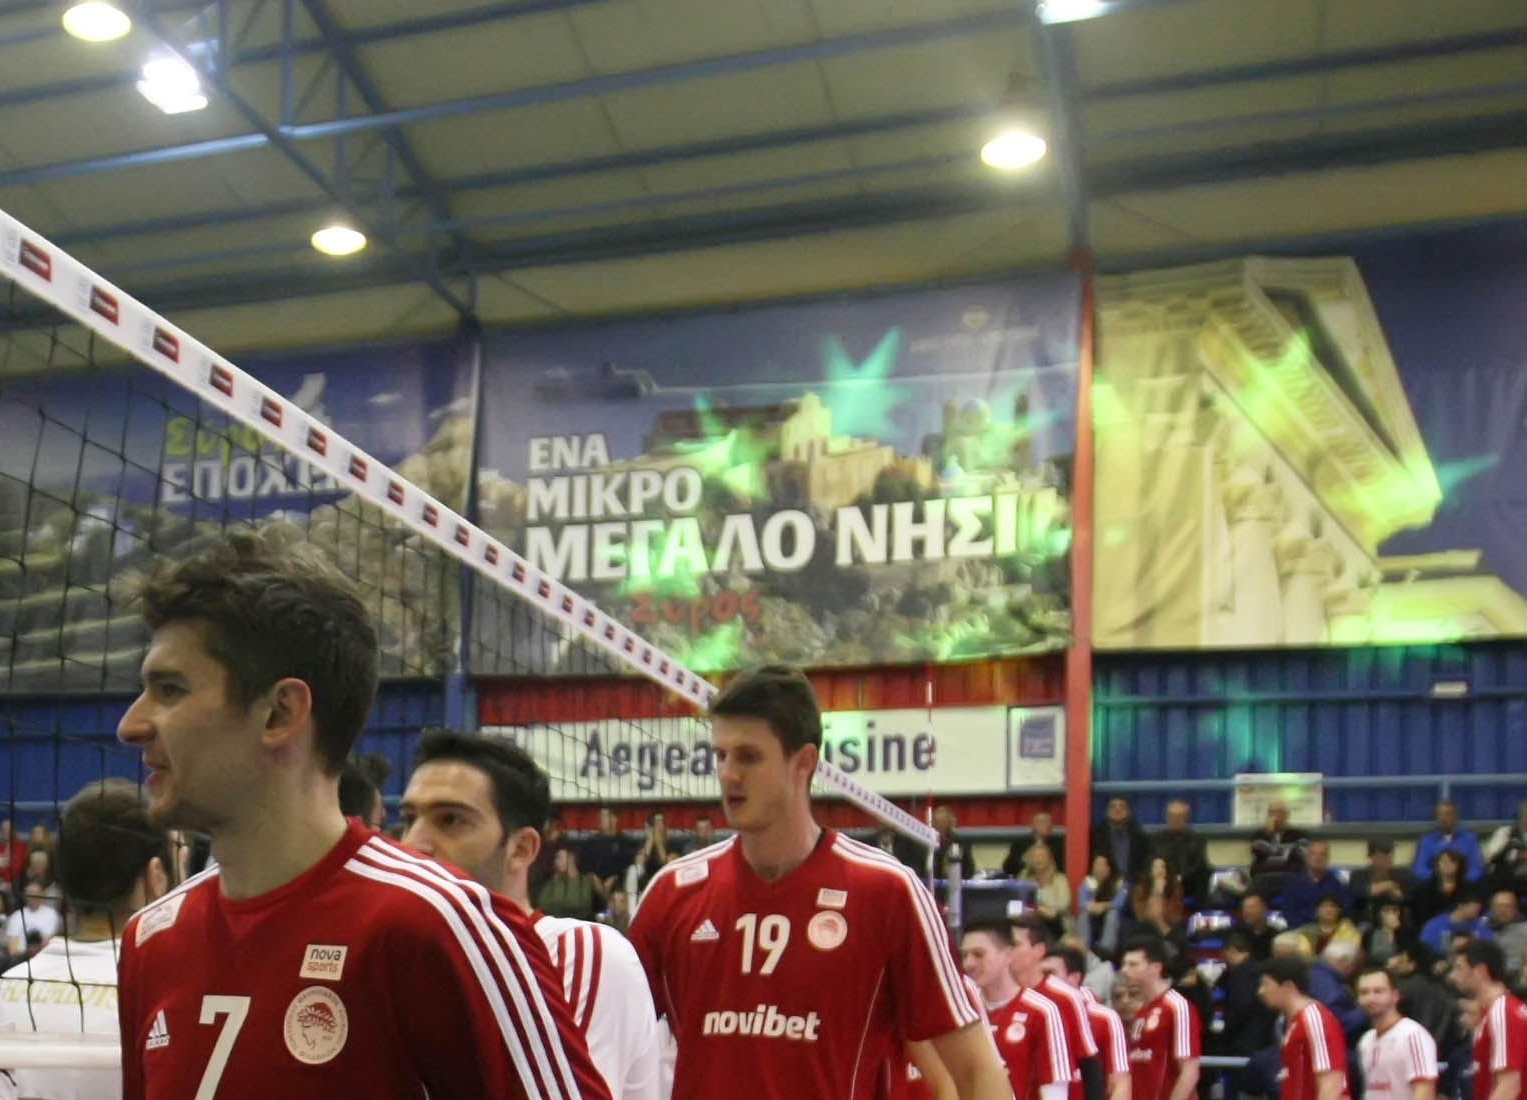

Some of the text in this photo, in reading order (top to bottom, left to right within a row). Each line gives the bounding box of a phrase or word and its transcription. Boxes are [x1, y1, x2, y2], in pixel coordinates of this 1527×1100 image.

[529, 433, 610, 471] ΕΝΑ
[160, 455, 343, 504] ΕΠΟΧΕ
[527, 466, 703, 521] ΜΙΚΡΟ
[526, 492, 1019, 583] ΜΕΓΑΛΟ ΝΗΣΙ
[579, 726, 717, 790] Aegea
[310, 948, 342, 961] nova
[735, 914, 790, 974] 19
[703, 1004, 821, 1041] novibet
